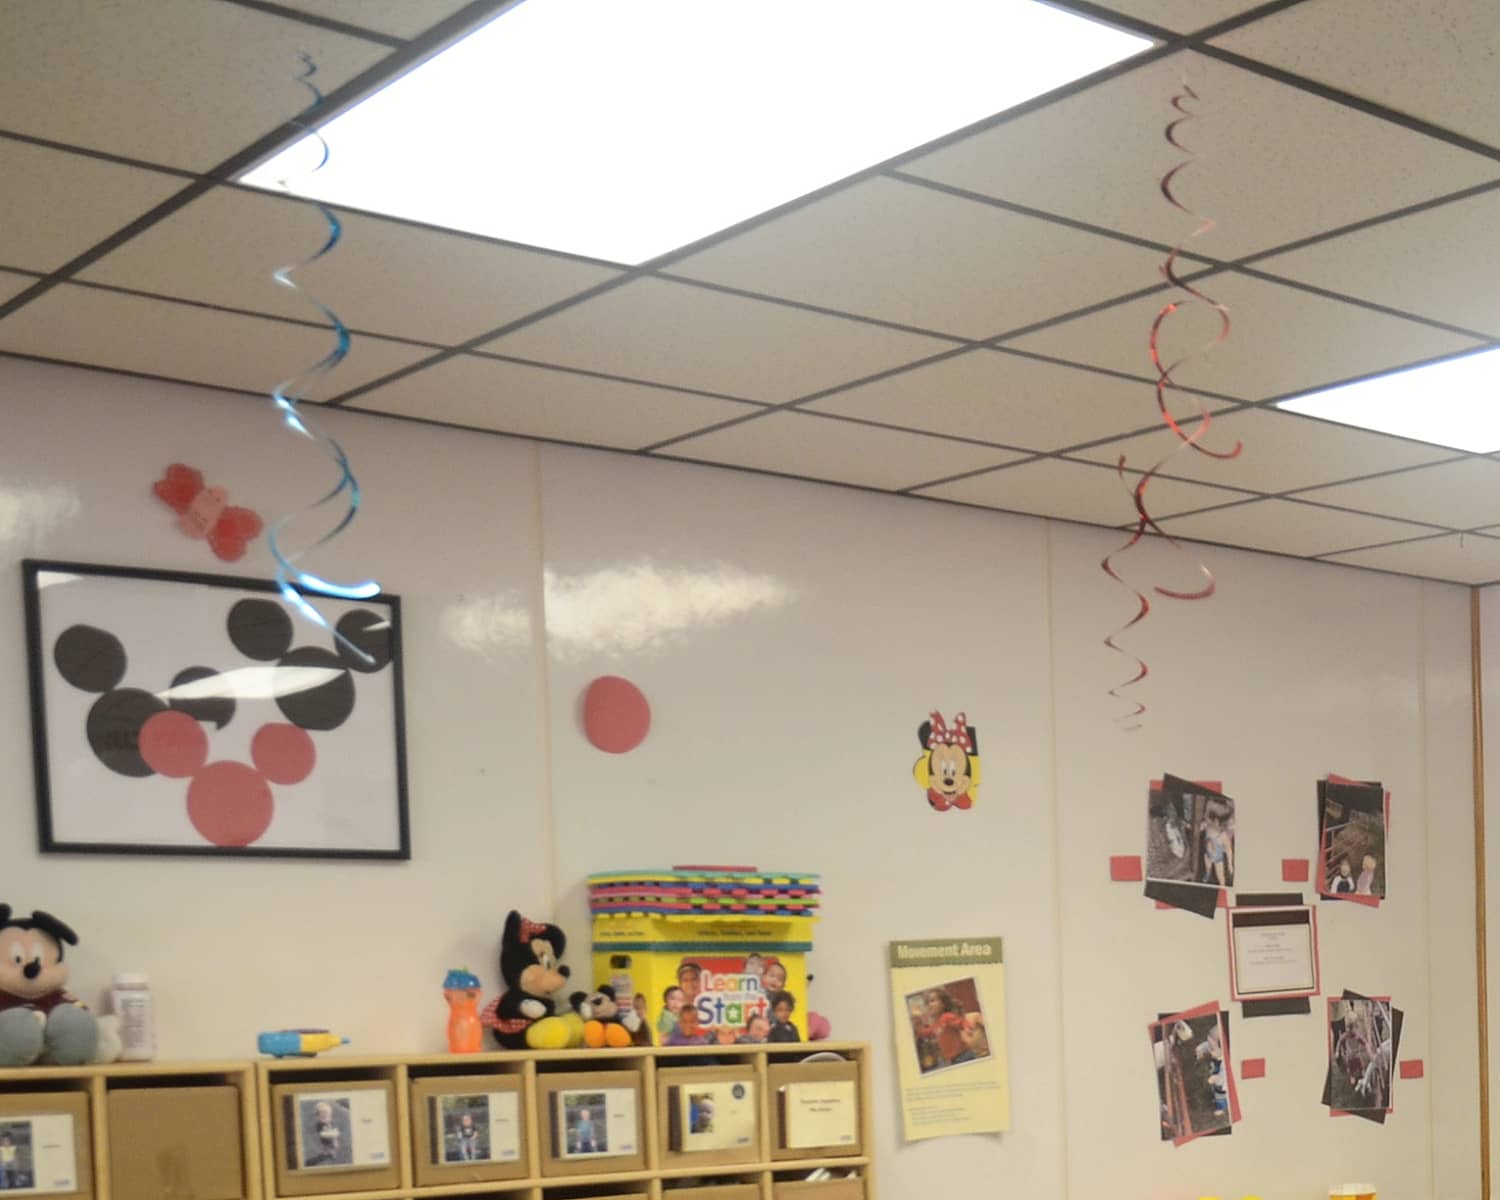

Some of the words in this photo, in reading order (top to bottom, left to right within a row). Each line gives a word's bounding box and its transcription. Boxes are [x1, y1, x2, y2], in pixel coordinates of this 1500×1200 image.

[960, 942, 992, 956] Area
[702, 972, 758, 992] Learn
[696, 995, 768, 1025] Start
